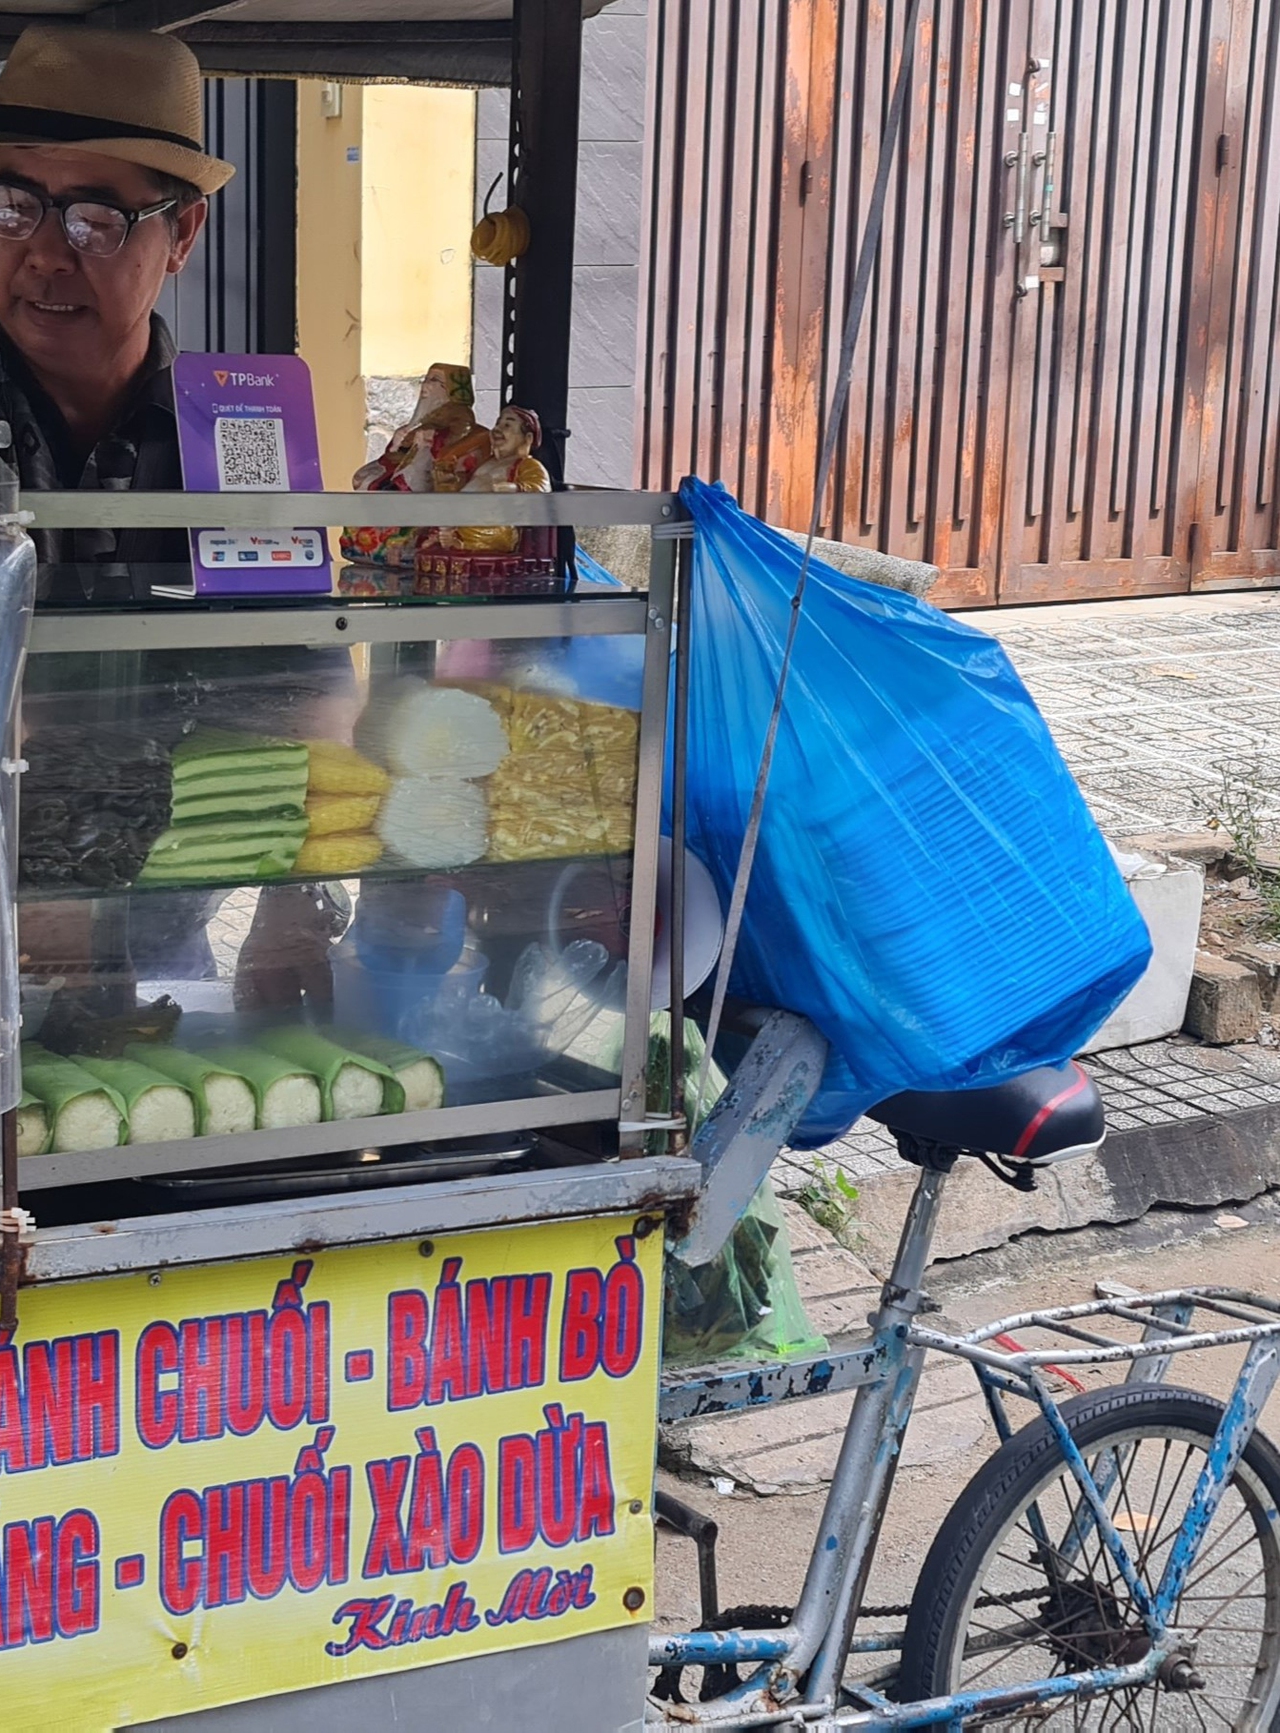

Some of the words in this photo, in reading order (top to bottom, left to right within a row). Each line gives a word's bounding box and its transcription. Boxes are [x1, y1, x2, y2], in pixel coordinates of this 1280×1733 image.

[230, 373, 275, 386] TPBank
[136, 1260, 330, 1449] CHUỐI
[345, 1349, 373, 1382] -
[387, 1256, 552, 1412] BÁNH
[559, 1234, 644, 1378] BÒ
[115, 1553, 143, 1590] -
[160, 1425, 352, 1615] CHUỐI
[362, 1427, 487, 1579] XÀO
[498, 1403, 615, 1555] DỪA
[485, 1564, 596, 1626] Mời
